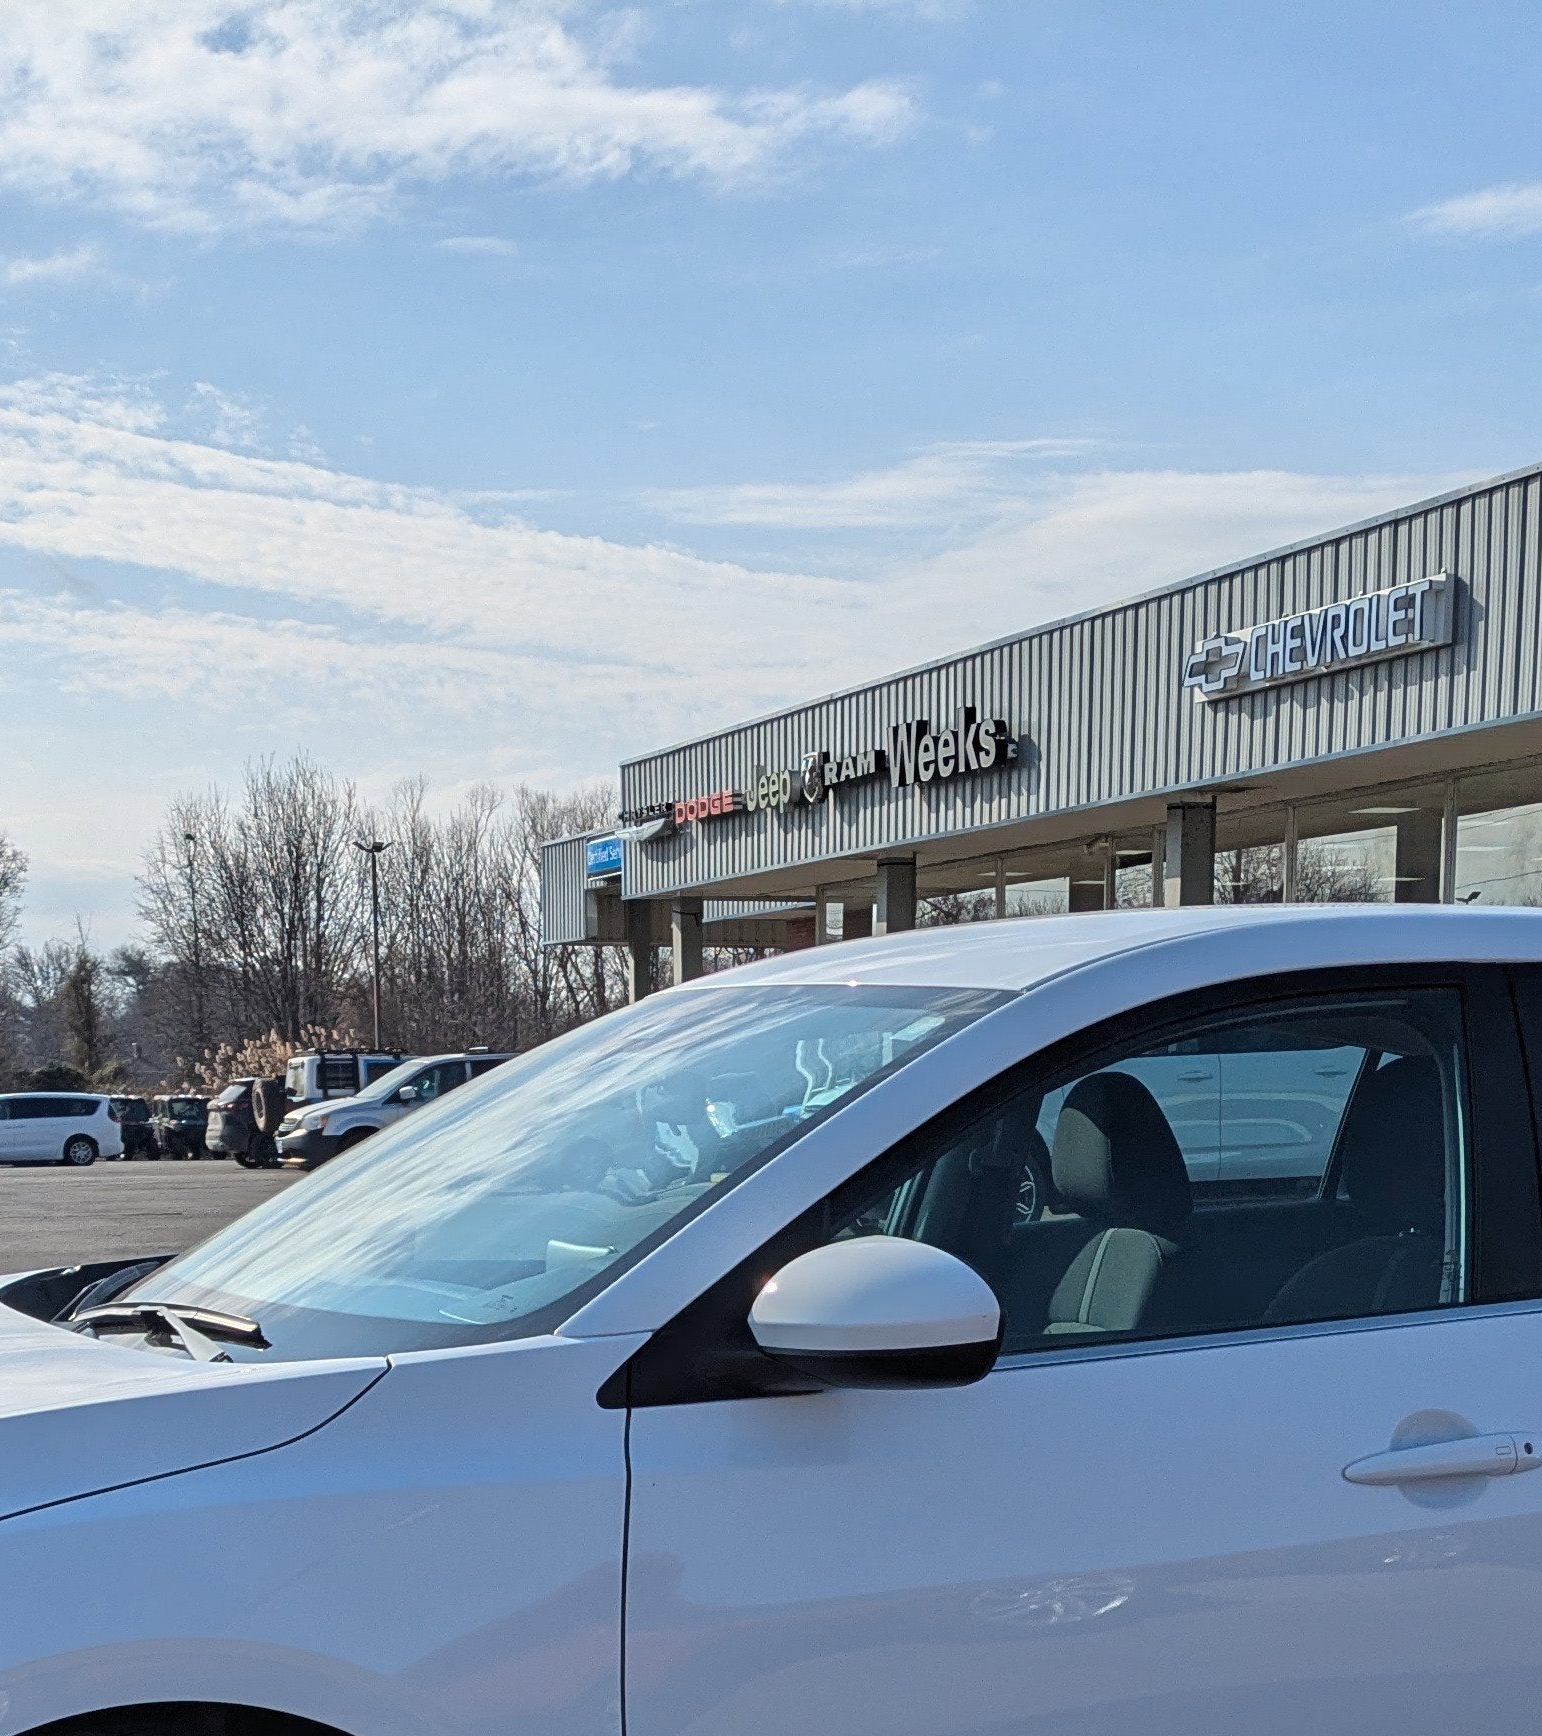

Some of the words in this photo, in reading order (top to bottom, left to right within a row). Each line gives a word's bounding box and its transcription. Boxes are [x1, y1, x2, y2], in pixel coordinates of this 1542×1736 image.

[1249, 580, 1431, 682] CHEVROLET
[674, 788, 734, 825] DODGE
[745, 769, 791, 814] Jeep
[824, 750, 876, 786] RAM
[887, 706, 997, 788] Weeks
